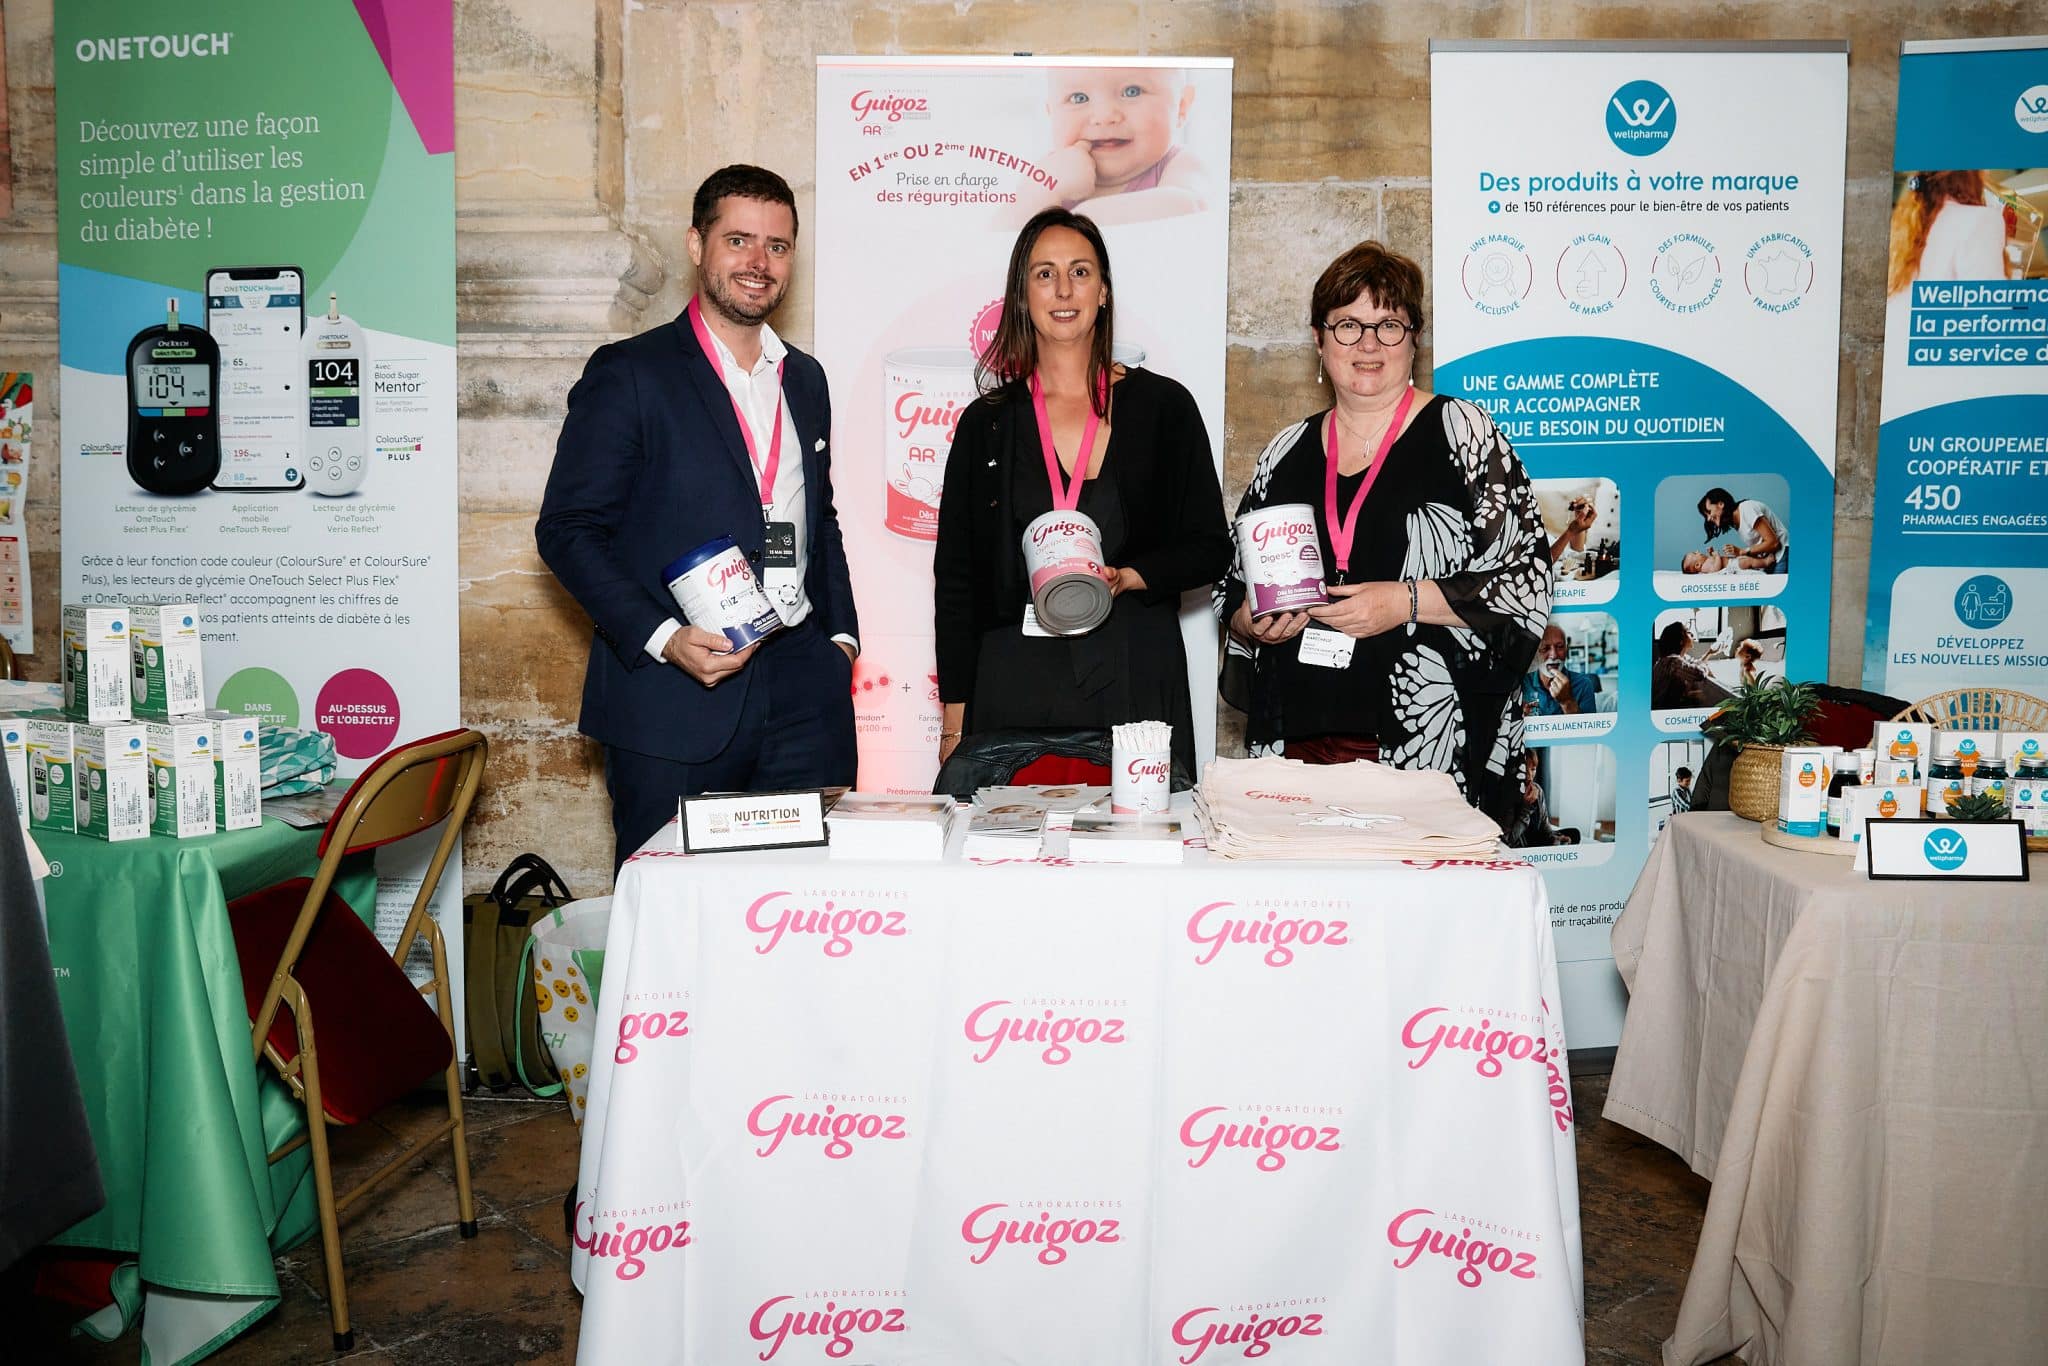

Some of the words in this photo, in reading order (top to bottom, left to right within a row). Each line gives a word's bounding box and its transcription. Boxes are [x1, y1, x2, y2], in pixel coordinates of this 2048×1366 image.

[850, 90, 927, 121] Guigoz
[80, 118, 199, 143] Découvrez
[205, 118, 249, 138] une
[256, 112, 320, 140] façon
[863, 126, 882, 135] AR
[1614, 129, 1669, 141] wellpharma
[80, 151, 155, 180] simple
[162, 149, 264, 173] d'utiliser
[271, 147, 303, 169] les
[849, 162, 871, 182] EN
[904, 144, 929, 160] OU
[969, 145, 1058, 191] INTENTION
[897, 172, 930, 185] Prise
[935, 174, 950, 186] en
[954, 172, 999, 189] charge
[1480, 173, 1520, 192] Des
[1529, 171, 1618, 196] produits
[1626, 169, 1641, 191] à
[1649, 171, 1703, 191] votre
[1712, 172, 1799, 195] marque
[191, 185, 246, 206] dans
[253, 181, 272, 202] la
[280, 178, 365, 206] gestion
[877, 190, 903, 202] des
[908, 190, 1016, 206] régurgitations
[1505, 201, 1518, 212] de
[1524, 201, 1543, 212] 150
[1546, 200, 1606, 212] références
[1610, 202, 1636, 215] pour
[1640, 201, 1649, 211] le
[1653, 200, 1703, 212] bien-être
[1706, 200, 1720, 211] de
[1723, 202, 1742, 211] vos
[1745, 200, 1790, 215] patients
[80, 220, 108, 243] du
[115, 217, 200, 240] diabète
[207, 217, 212, 238] !
[1470, 239, 1487, 252] UNE
[1488, 234, 1525, 252] MARQUE
[1573, 236, 1586, 246] UN
[1588, 234, 1611, 246] GAIN
[1658, 239, 1673, 253] DES
[1674, 234, 1715, 253] FORMULES
[1747, 243, 1761, 258] UNE
[1761, 233, 1812, 257] FABRICATION
[1650, 279, 1675, 311] COURTES
[1689, 278, 1722, 312] EFFICACES
[1475, 301, 1520, 315] EXCLUSIVE
[1570, 302, 1581, 312] DE
[1582, 301, 1614, 315] MARGE
[1916, 315, 1936, 332] la
[1943, 314, 2048, 336] performa
[1914, 348, 1942, 361] au
[1949, 344, 2028, 361] service
[315, 361, 353, 381] 104
[398, 372, 420, 380] Sugar
[149, 375, 185, 399] 104
[1463, 375, 1498, 391] UNE
[1504, 374, 1564, 390] GAMME
[1570, 369, 1659, 389] COMPLÈTE
[1472, 398, 1509, 414] OUR
[1514, 396, 1640, 413] ACCOMPAGNER
[1499, 421, 1533, 437] QUE
[1540, 419, 1599, 436] BESOIN
[1606, 419, 1628, 435] DU
[1633, 417, 1724, 436] QUOTIDIEN
[1909, 437, 1934, 452] UN
[1941, 437, 2048, 453] GROUPEME
[909, 447, 936, 463] AR
[1907, 457, 2022, 475] COOPÉRATIF
[1904, 485, 1961, 510] 450
[232, 504, 278, 513] Application
[241, 515, 269, 523] mobile
[1903, 514, 1978, 525] PHARMACIES
[1982, 514, 2047, 526] ENGAGÉES
[1033, 521, 1093, 547] Guigoz
[1253, 521, 1313, 551] Guigoz
[81, 555, 113, 567] Grâce
[116, 556, 124, 567] à
[127, 556, 147, 566] leur
[151, 555, 198, 566] fonction
[201, 556, 228, 566] code
[231, 556, 272, 567] couleur
[350, 557, 361, 567] et
[81, 574, 110, 586] Plus),
[112, 574, 128, 585] les
[131, 574, 175, 585] lecteurs
[178, 574, 193, 585] de
[195, 573, 246, 587] glycémie
[249, 575, 304, 586] OneTouch
[308, 575, 342, 585] Select
[346, 575, 369, 585] Plus
[1681, 584, 1728, 593] GROSSESSE
[1730, 584, 1736, 592] &
[1739, 582, 1760, 591] BÉBÉ
[95, 593, 149, 604] OneTouch
[231, 594, 315, 607] accompagnent
[320, 594, 335, 605] les
[338, 594, 381, 605] chiffres
[384, 594, 398, 605] de
[200, 613, 218, 623] vos
[221, 613, 268, 626] patients
[271, 613, 315, 624] atteints
[319, 614, 333, 624] de
[337, 613, 380, 624] diabète
[395, 613, 410, 624] les
[1937, 635, 2024, 649] DÉVELOPPEZ
[1894, 654, 1916, 664] LES
[1921, 654, 2000, 665] NOUVELLES
[2005, 655, 2048, 666] MISSIO
[244, 704, 272, 712] DANS
[329, 705, 386, 713] AU-DESSUS
[321, 716, 334, 724] DE
[1551, 720, 1611, 731] ALIMENTAIRES
[1245, 790, 1311, 803] Guigoz
[734, 807, 800, 822] NUTRITION
[1522, 853, 1578, 862] OBIOTIQUES
[803, 889, 908, 899] LABORATOIRES
[1245, 898, 1351, 908] LABORATOIRES
[1567, 904, 1578, 913] de
[1580, 903, 1596, 912] nos
[746, 891, 906, 958] Guigoz
[1569, 915, 1614, 927] traçabilité,
[1187, 901, 1348, 967] Guigoz
[1022, 997, 1128, 1006] LABORATOIRES
[964, 1000, 1125, 1065] Guigoz
[1401, 1007, 1547, 1078] Guigoz
[804, 1093, 908, 1104] LABORATOIRES
[1238, 1104, 1344, 1115] LABORATOIRES
[747, 1095, 906, 1159] Guigoz
[1179, 1106, 1340, 1172] Guigoz
[1018, 1200, 1123, 1208] LABORATOIRES
[961, 1202, 1120, 1265] Guigoz
[1444, 1211, 1544, 1242] LABORATOIRES
[1387, 1208, 1537, 1288] Guigoz
[805, 1289, 908, 1298] LABORATOIRES
[1229, 1296, 1327, 1312] LABORATOIRES
[750, 1295, 905, 1361] Guigoz
[1171, 1306, 1323, 1365] Guigoz
